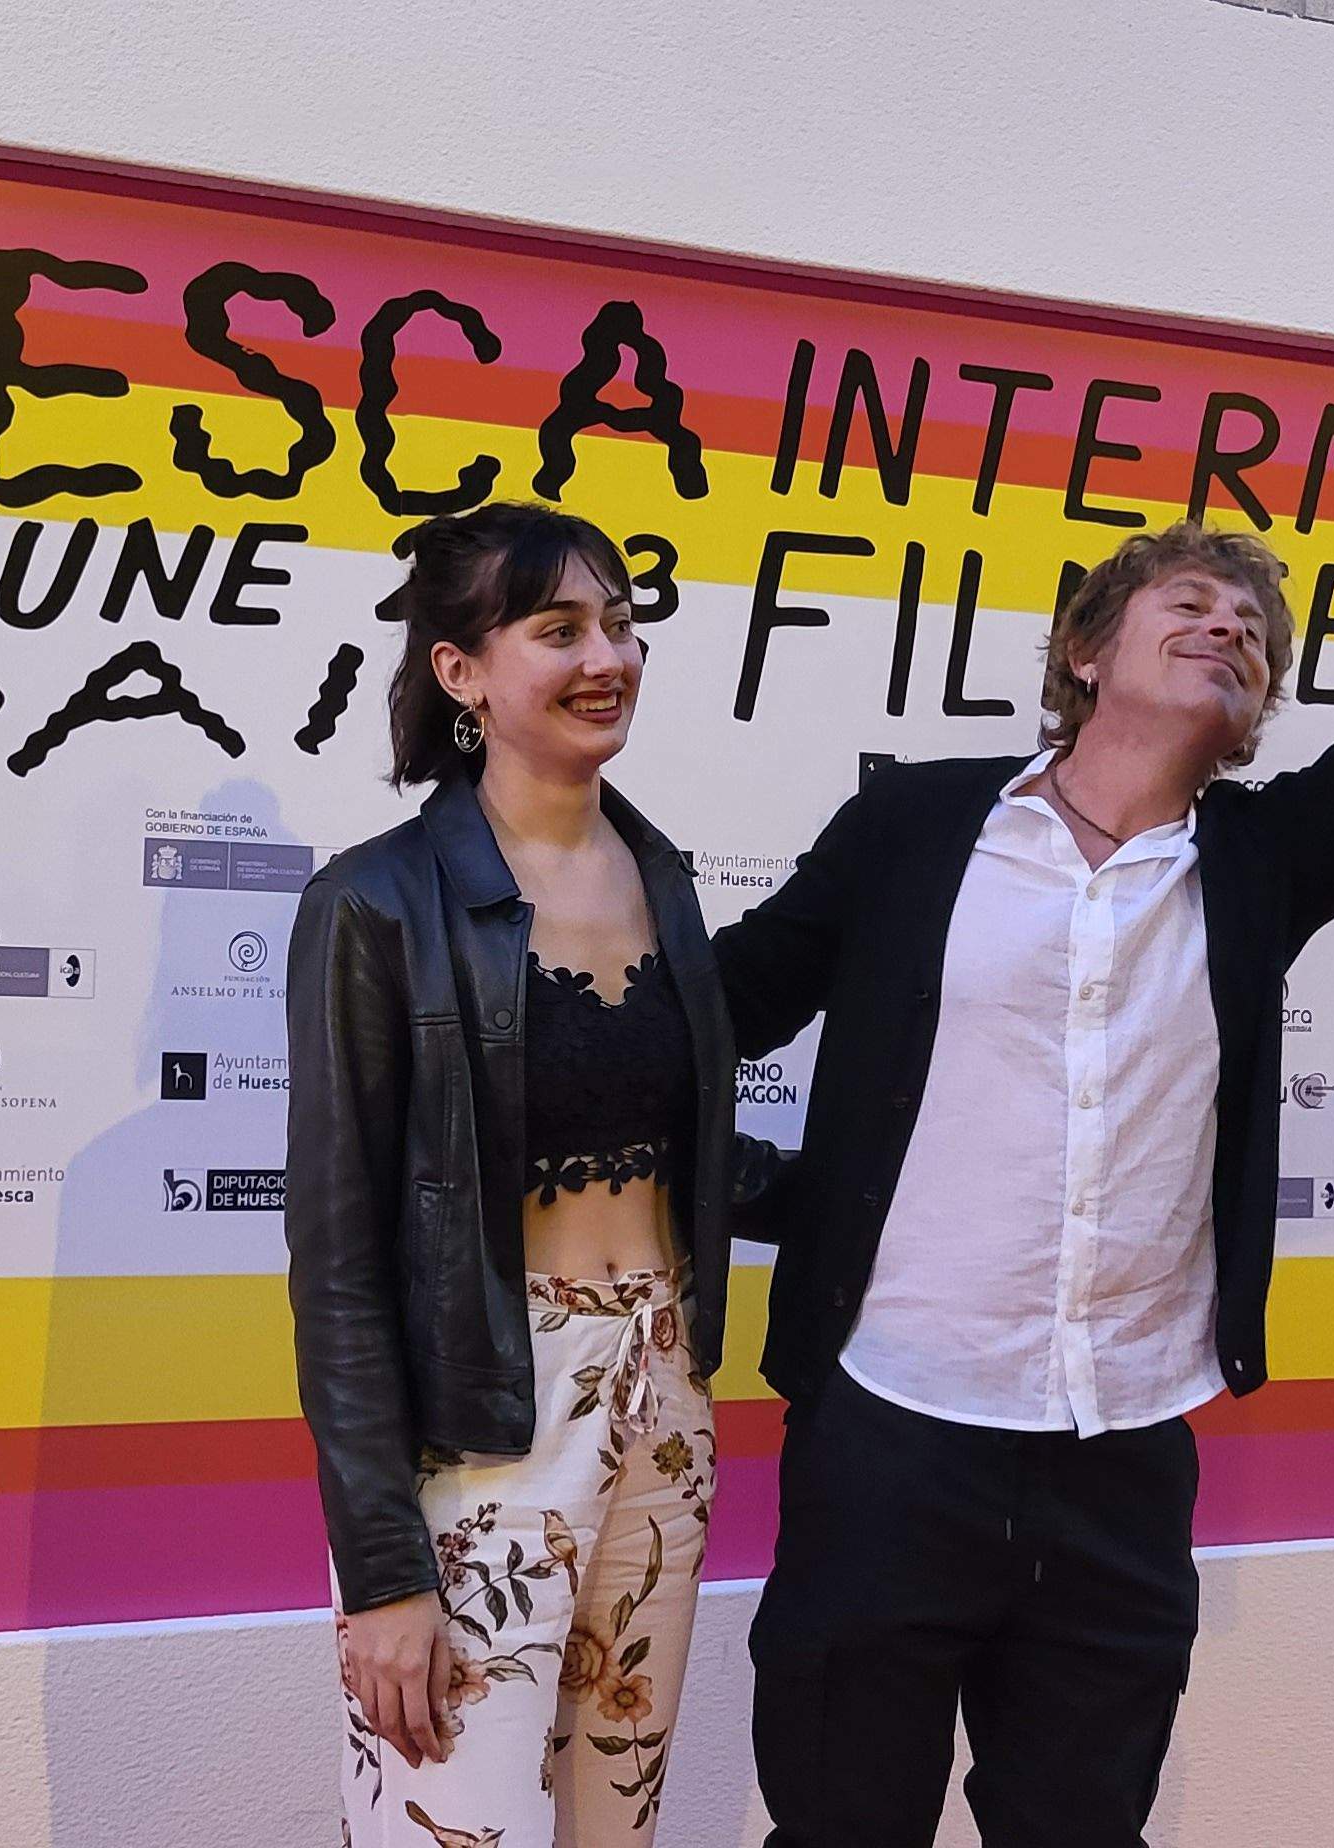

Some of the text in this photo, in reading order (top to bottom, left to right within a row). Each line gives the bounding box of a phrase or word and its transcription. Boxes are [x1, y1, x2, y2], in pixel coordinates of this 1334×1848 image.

[732, 531, 1087, 723] FIL
[146, 809, 252, 823] Con la financiación de
[145, 822, 268, 838] GOBIERNO DE ESPAÑA
[698, 851, 797, 871] Ayuntamiento
[698, 871, 773, 887] de Huesca
[171, 986, 236, 998] ANSELMO
[243, 986, 264, 998] PIÉ
[213, 1053, 287, 1072] Ayuntam
[213, 1074, 290, 1090] de Huesc
[1, 1097, 57, 1108] SOPENA
[212, 1192, 234, 1206] DE
